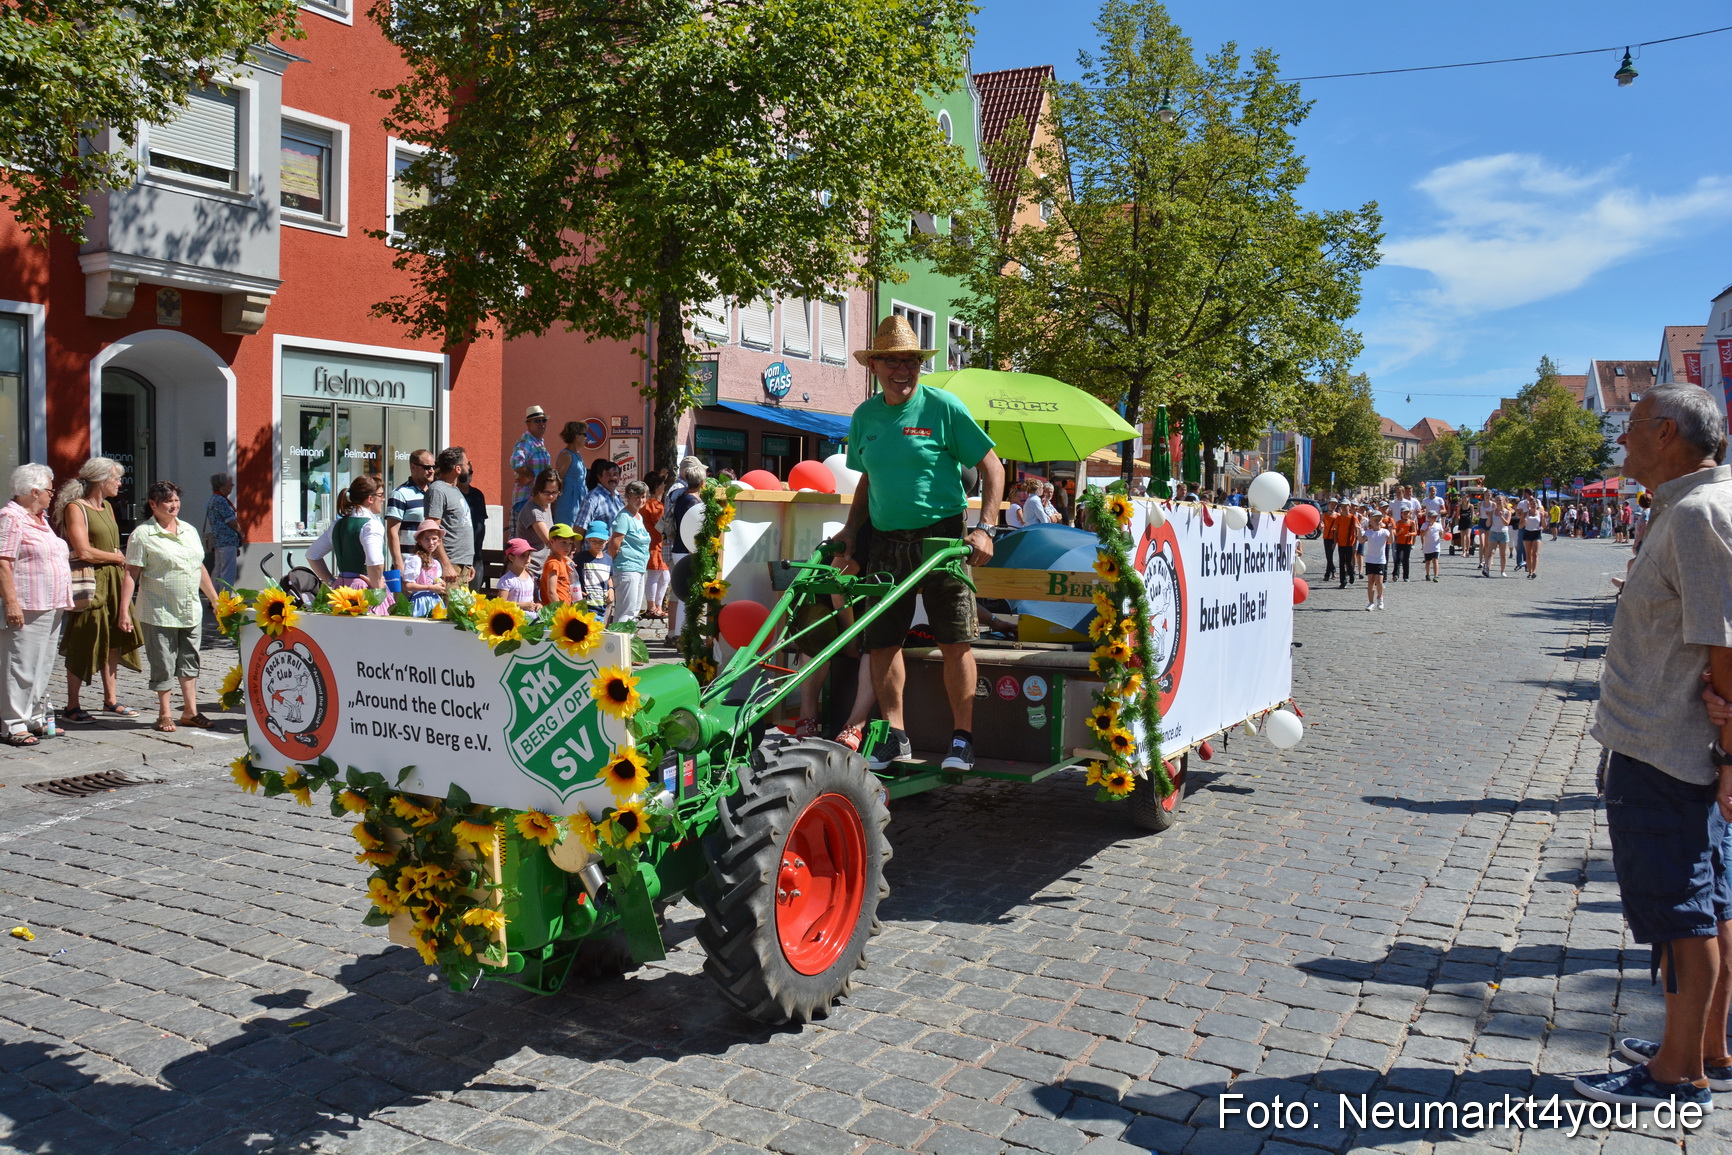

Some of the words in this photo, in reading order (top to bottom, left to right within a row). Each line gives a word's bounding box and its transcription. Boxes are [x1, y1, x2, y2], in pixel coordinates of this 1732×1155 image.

[314, 366, 406, 400] fielmann
[764, 365, 780, 379] vom
[768, 373, 792, 393] FASS
[989, 398, 1059, 412] BOCK
[290, 445, 324, 457] fielmann
[344, 448, 376, 460] fielmann
[1144, 560, 1168, 589] ock'n'Roll
[1200, 541, 1218, 577] It's
[1219, 542, 1242, 582] only
[1150, 581, 1162, 602] Club
[1199, 597, 1220, 633] but
[1221, 602, 1237, 628] we
[1239, 592, 1256, 625] like
[1258, 590, 1268, 621] it!
[276, 668, 293, 681] Club
[356, 661, 437, 685] Rock'n'Roll
[441, 669, 475, 689] Club
[518, 661, 562, 714] DJK
[411, 696, 437, 715] the
[350, 718, 368, 736] im
[372, 721, 421, 742] DJK-SV
[426, 728, 460, 752] Berg
[464, 733, 492, 752] e.V.
[520, 715, 558, 756] BERG
[550, 725, 595, 781] SV
